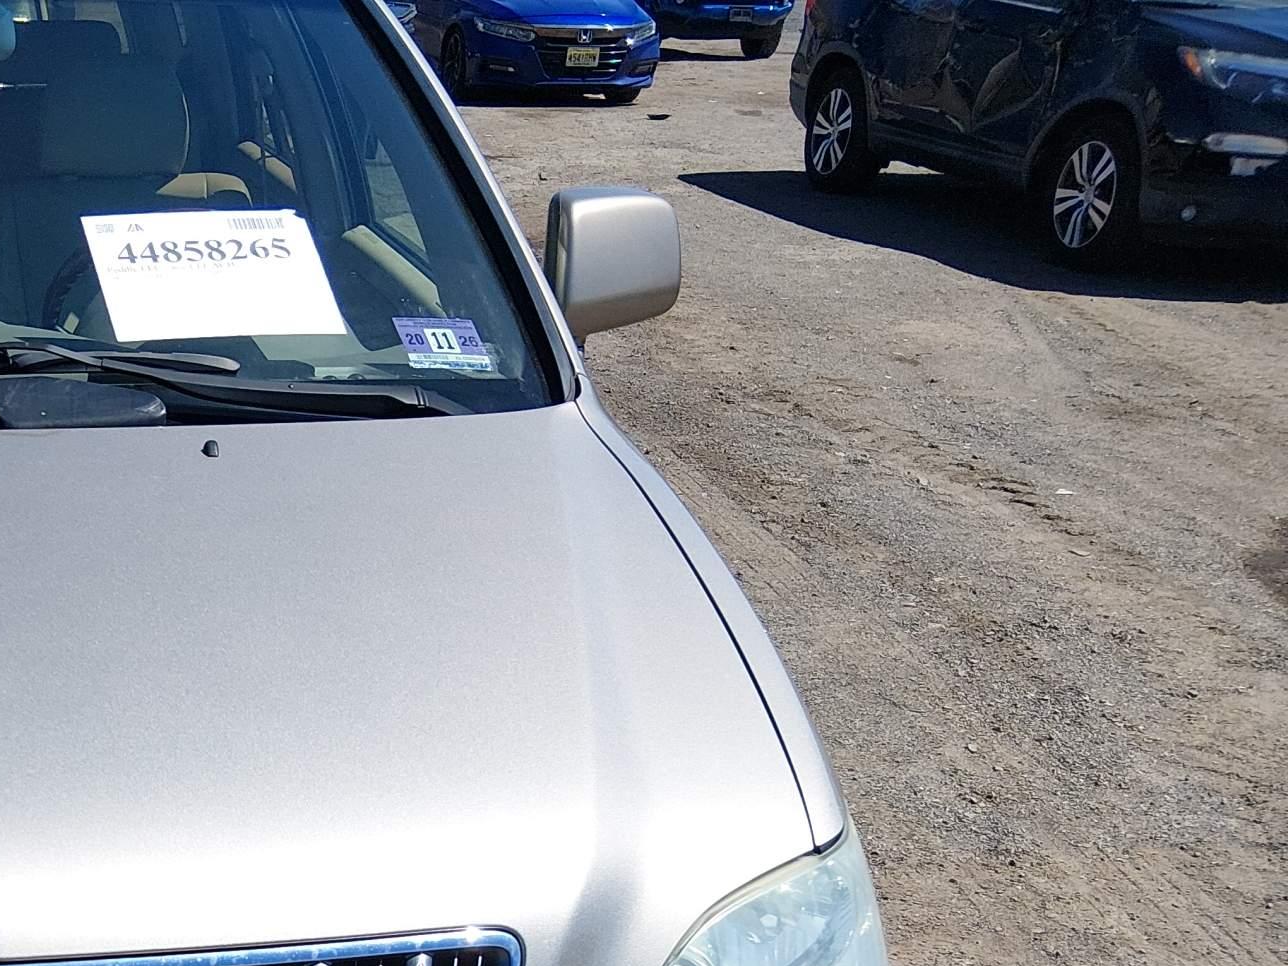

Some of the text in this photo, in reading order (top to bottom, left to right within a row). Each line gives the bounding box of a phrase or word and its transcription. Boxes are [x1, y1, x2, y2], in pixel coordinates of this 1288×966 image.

[117, 237, 292, 264] 44858265
[405, 333, 425, 346] 20
[431, 331, 456, 350] 11
